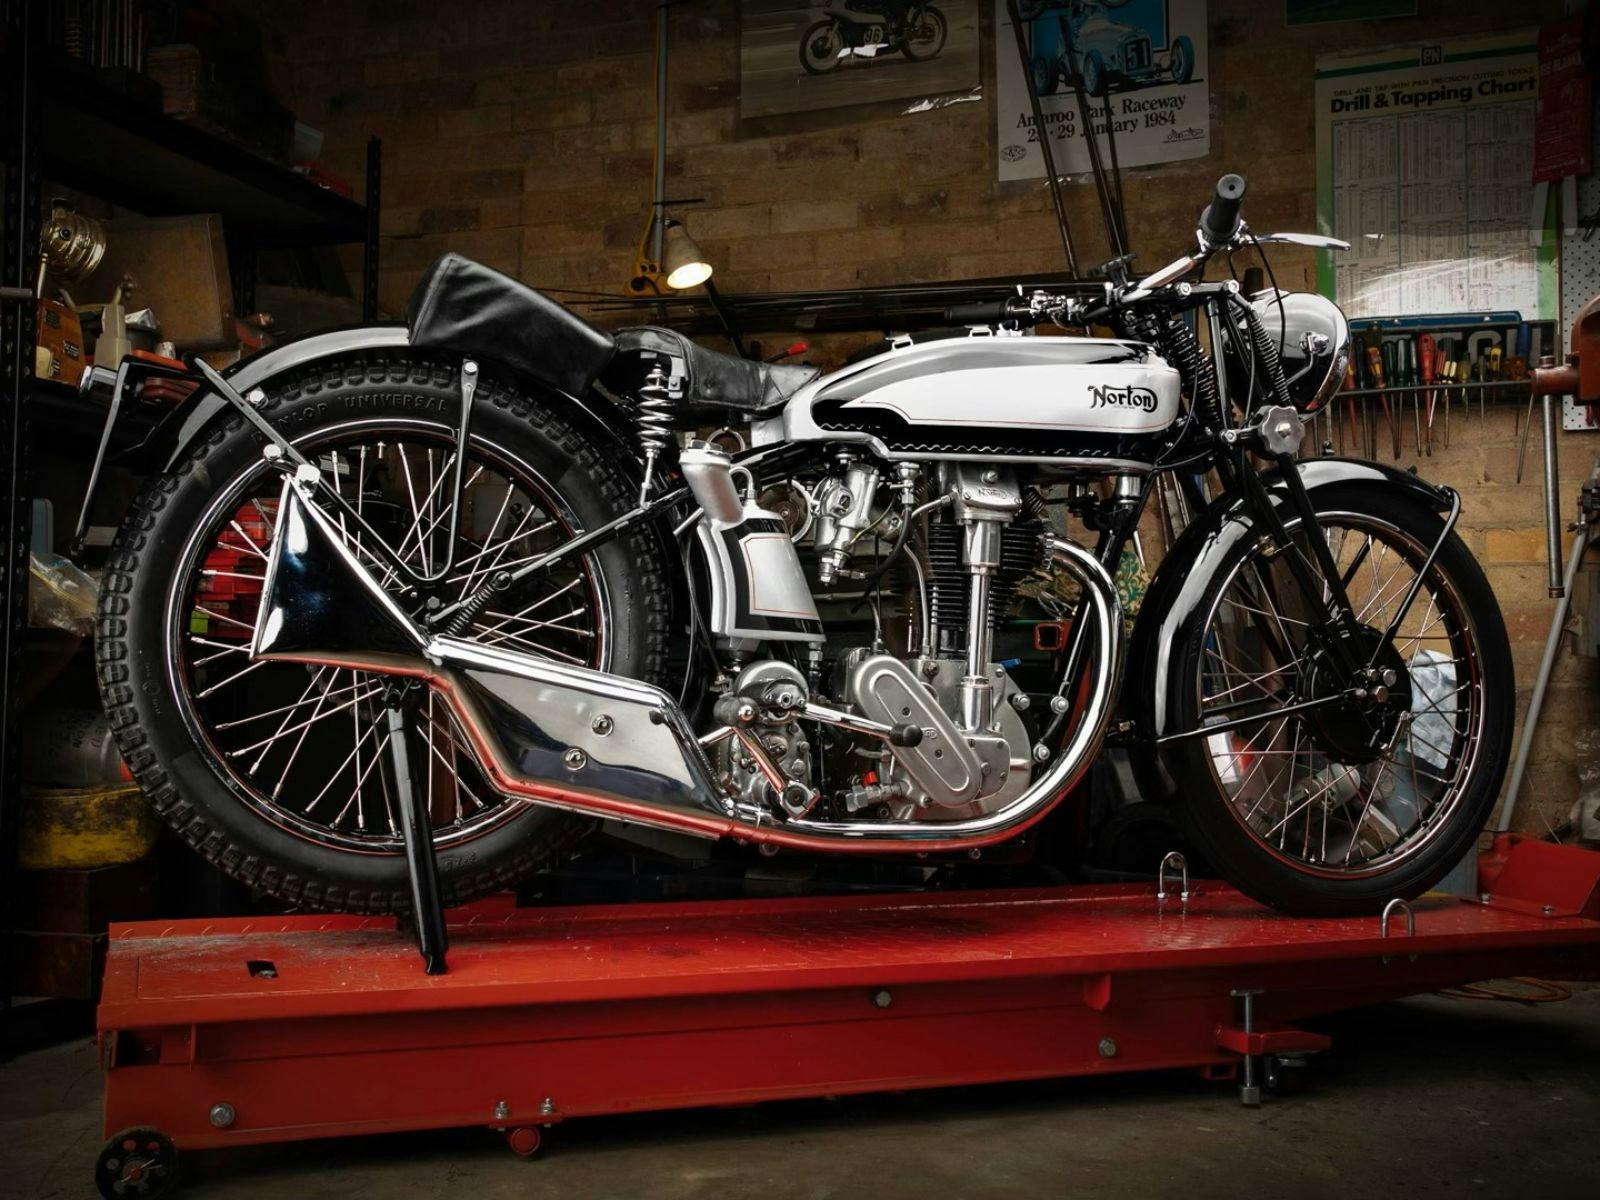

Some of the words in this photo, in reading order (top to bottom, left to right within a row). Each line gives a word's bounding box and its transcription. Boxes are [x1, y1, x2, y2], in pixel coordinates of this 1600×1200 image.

[1123, 95, 1186, 114] Raceway
[1331, 93, 1370, 113] Drill
[1374, 93, 1388, 108] &
[1391, 85, 1472, 107] Tapping
[1478, 76, 1537, 96] Chart
[1057, 122, 1076, 140] 29
[1143, 109, 1176, 129] 1984
[1087, 384, 1159, 413] Norton
